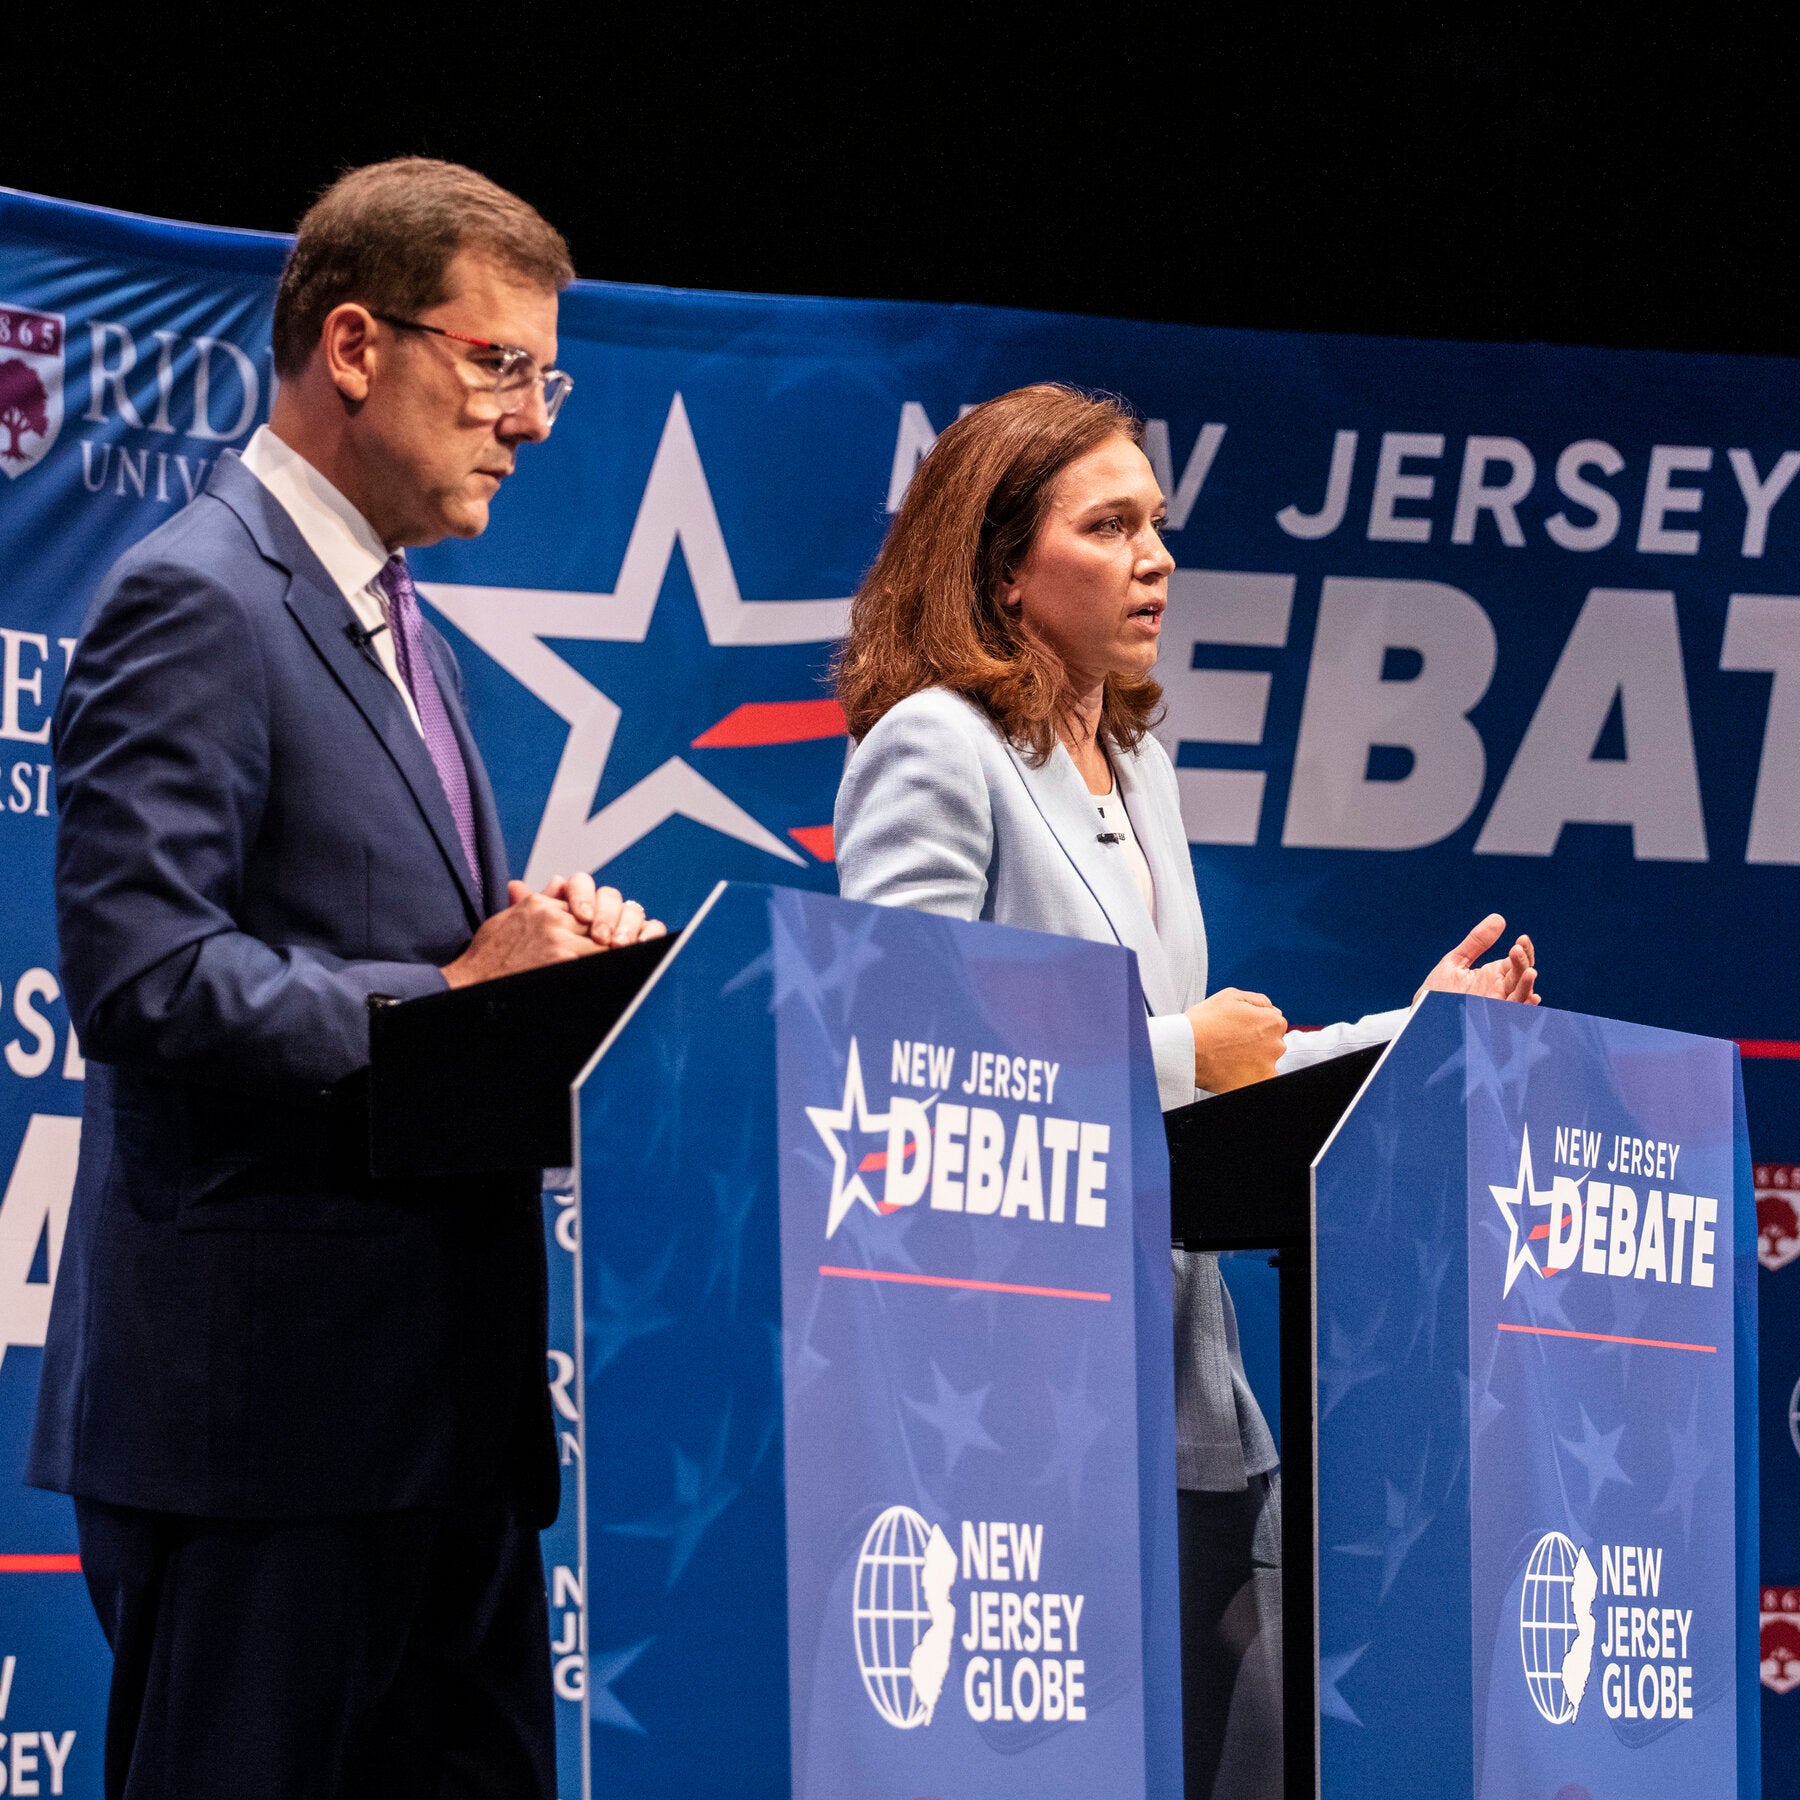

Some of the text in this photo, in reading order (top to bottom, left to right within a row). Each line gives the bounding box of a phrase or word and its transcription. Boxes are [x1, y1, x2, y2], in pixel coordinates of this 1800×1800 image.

[83, 320, 280, 441] RID
[1276, 429, 1800, 559] JERSEY
[0, 627, 78, 745] E
[0, 761, 51, 817] SI
[891, 1039, 1060, 1104] NEW JERSEY
[884, 1096, 1111, 1228] DEBATE
[1554, 1125, 1680, 1180] NEW JERSEY
[1547, 1175, 1718, 1288] DEBATE
[961, 1520, 1043, 1582] NEW
[1602, 1544, 1663, 1597] NEW
[961, 1591, 1084, 1652] JERSEY
[1601, 1606, 1693, 1659] JERSEY
[964, 1656, 1087, 1723] GLOBE
[1602, 1662, 1693, 1720] GLOBE
